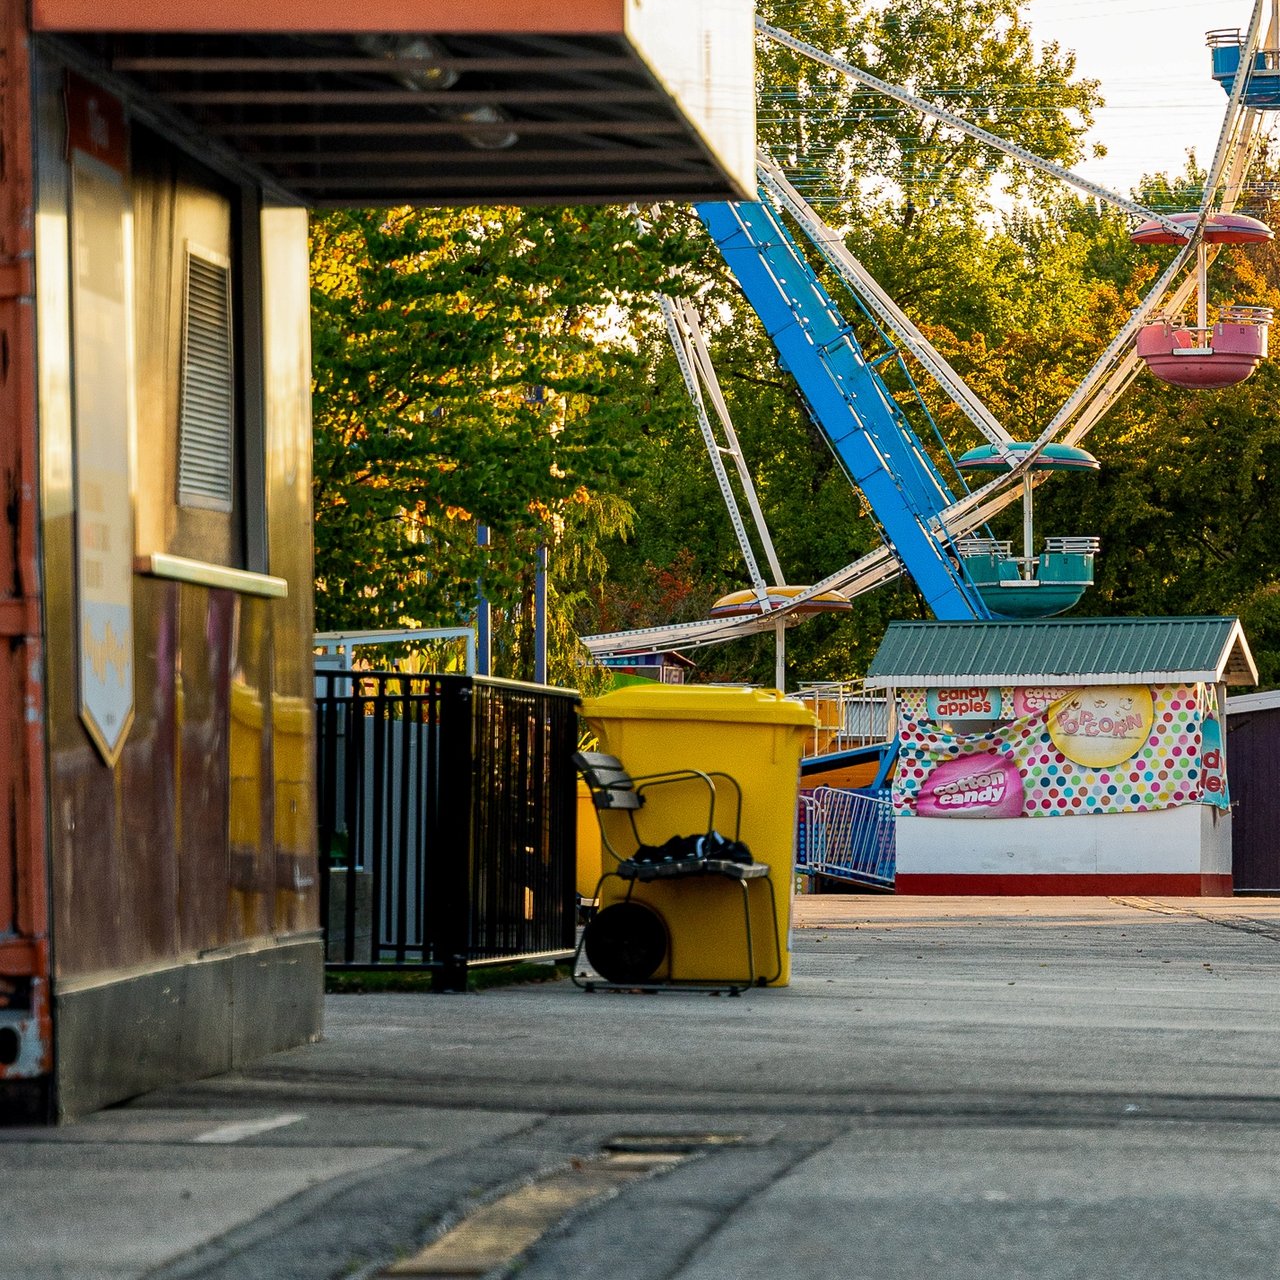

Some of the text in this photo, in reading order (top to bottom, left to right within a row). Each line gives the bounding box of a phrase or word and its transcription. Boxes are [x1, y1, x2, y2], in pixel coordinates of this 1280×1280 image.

[1024, 687, 1067, 699] cotto
[937, 699, 992, 716] apples
[1056, 710, 1143, 738] POPCORN
[933, 772, 1004, 796] cotton
[939, 786, 1005, 805] candy
